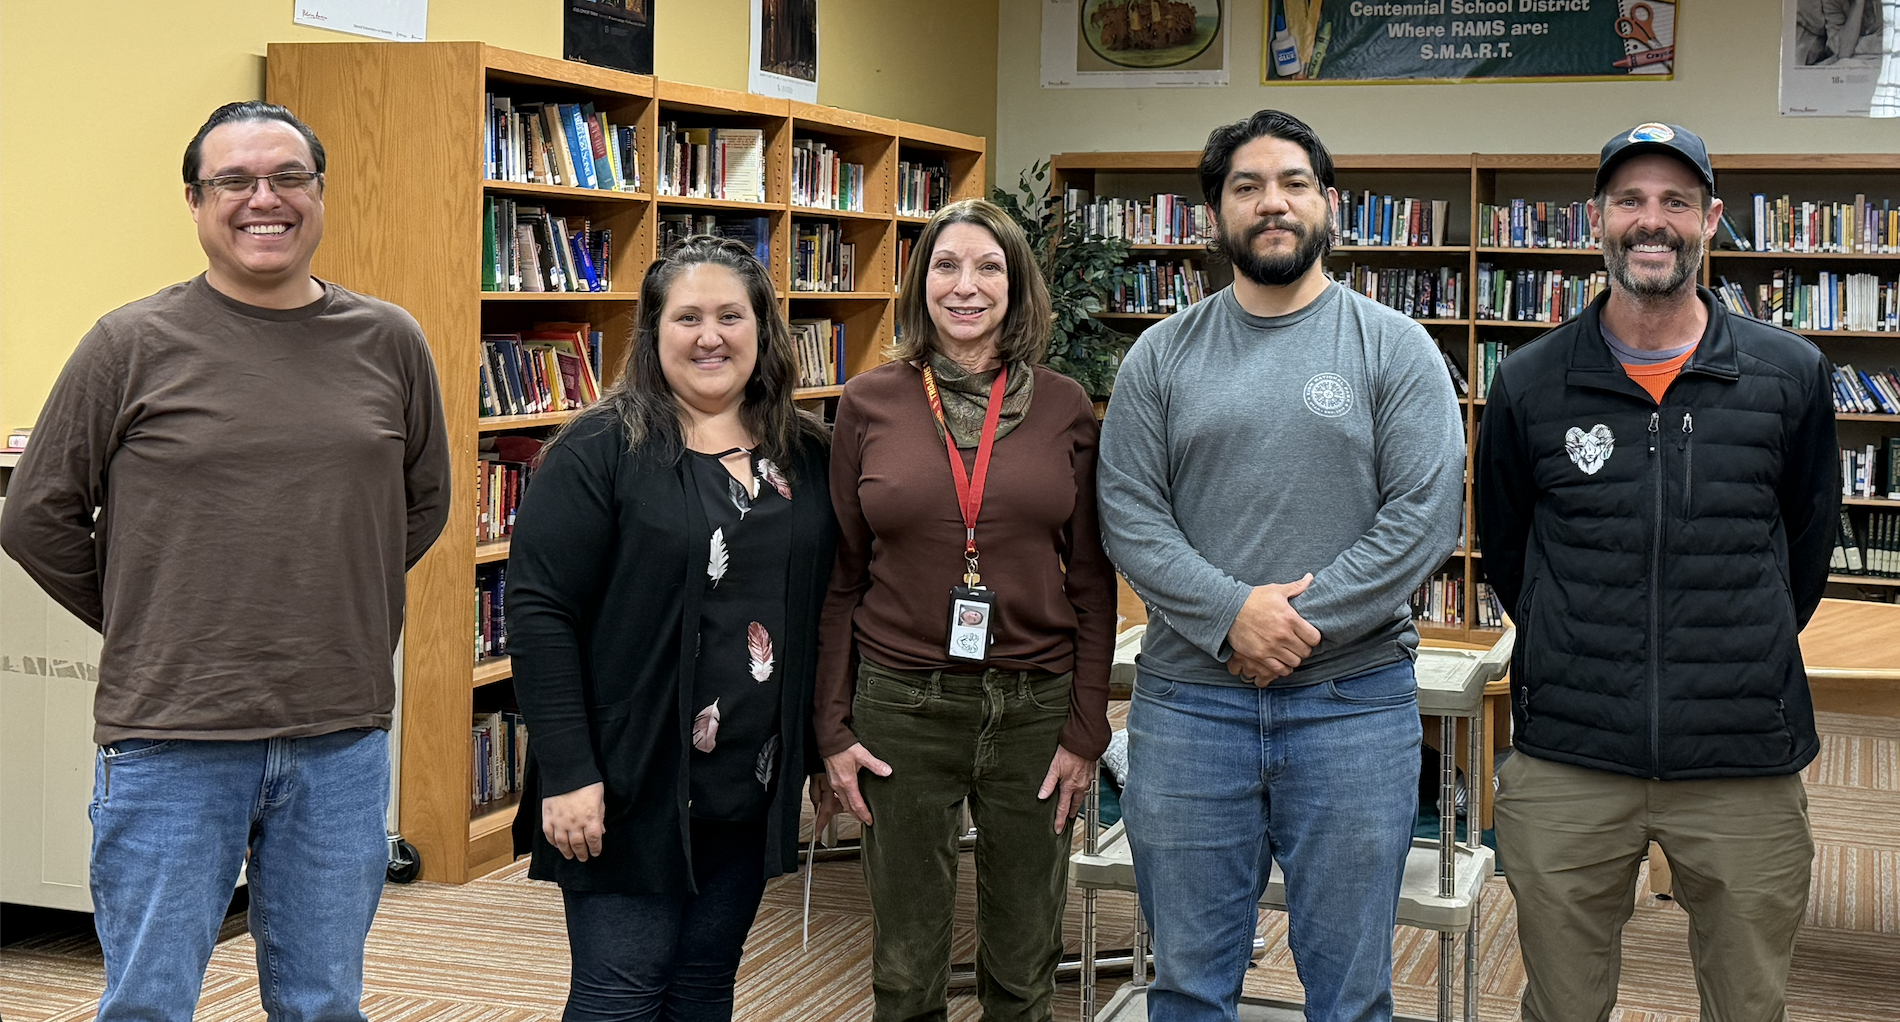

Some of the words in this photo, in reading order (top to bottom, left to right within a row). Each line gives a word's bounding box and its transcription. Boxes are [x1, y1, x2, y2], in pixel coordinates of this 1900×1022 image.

[1350, 0, 1445, 17] Centennial
[1450, 0, 1513, 15] School
[1518, 0, 1590, 13] District
[1387, 21, 1446, 39] Where
[1451, 19, 1506, 37] RAMS
[1510, 22, 1549, 36] are:
[1278, 53, 1296, 62] GLUE
[1420, 42, 1513, 60] S.M.A.R.T.
[923, 365, 937, 401] TROJANS
[1314, 375, 1344, 386] NATIONAL
